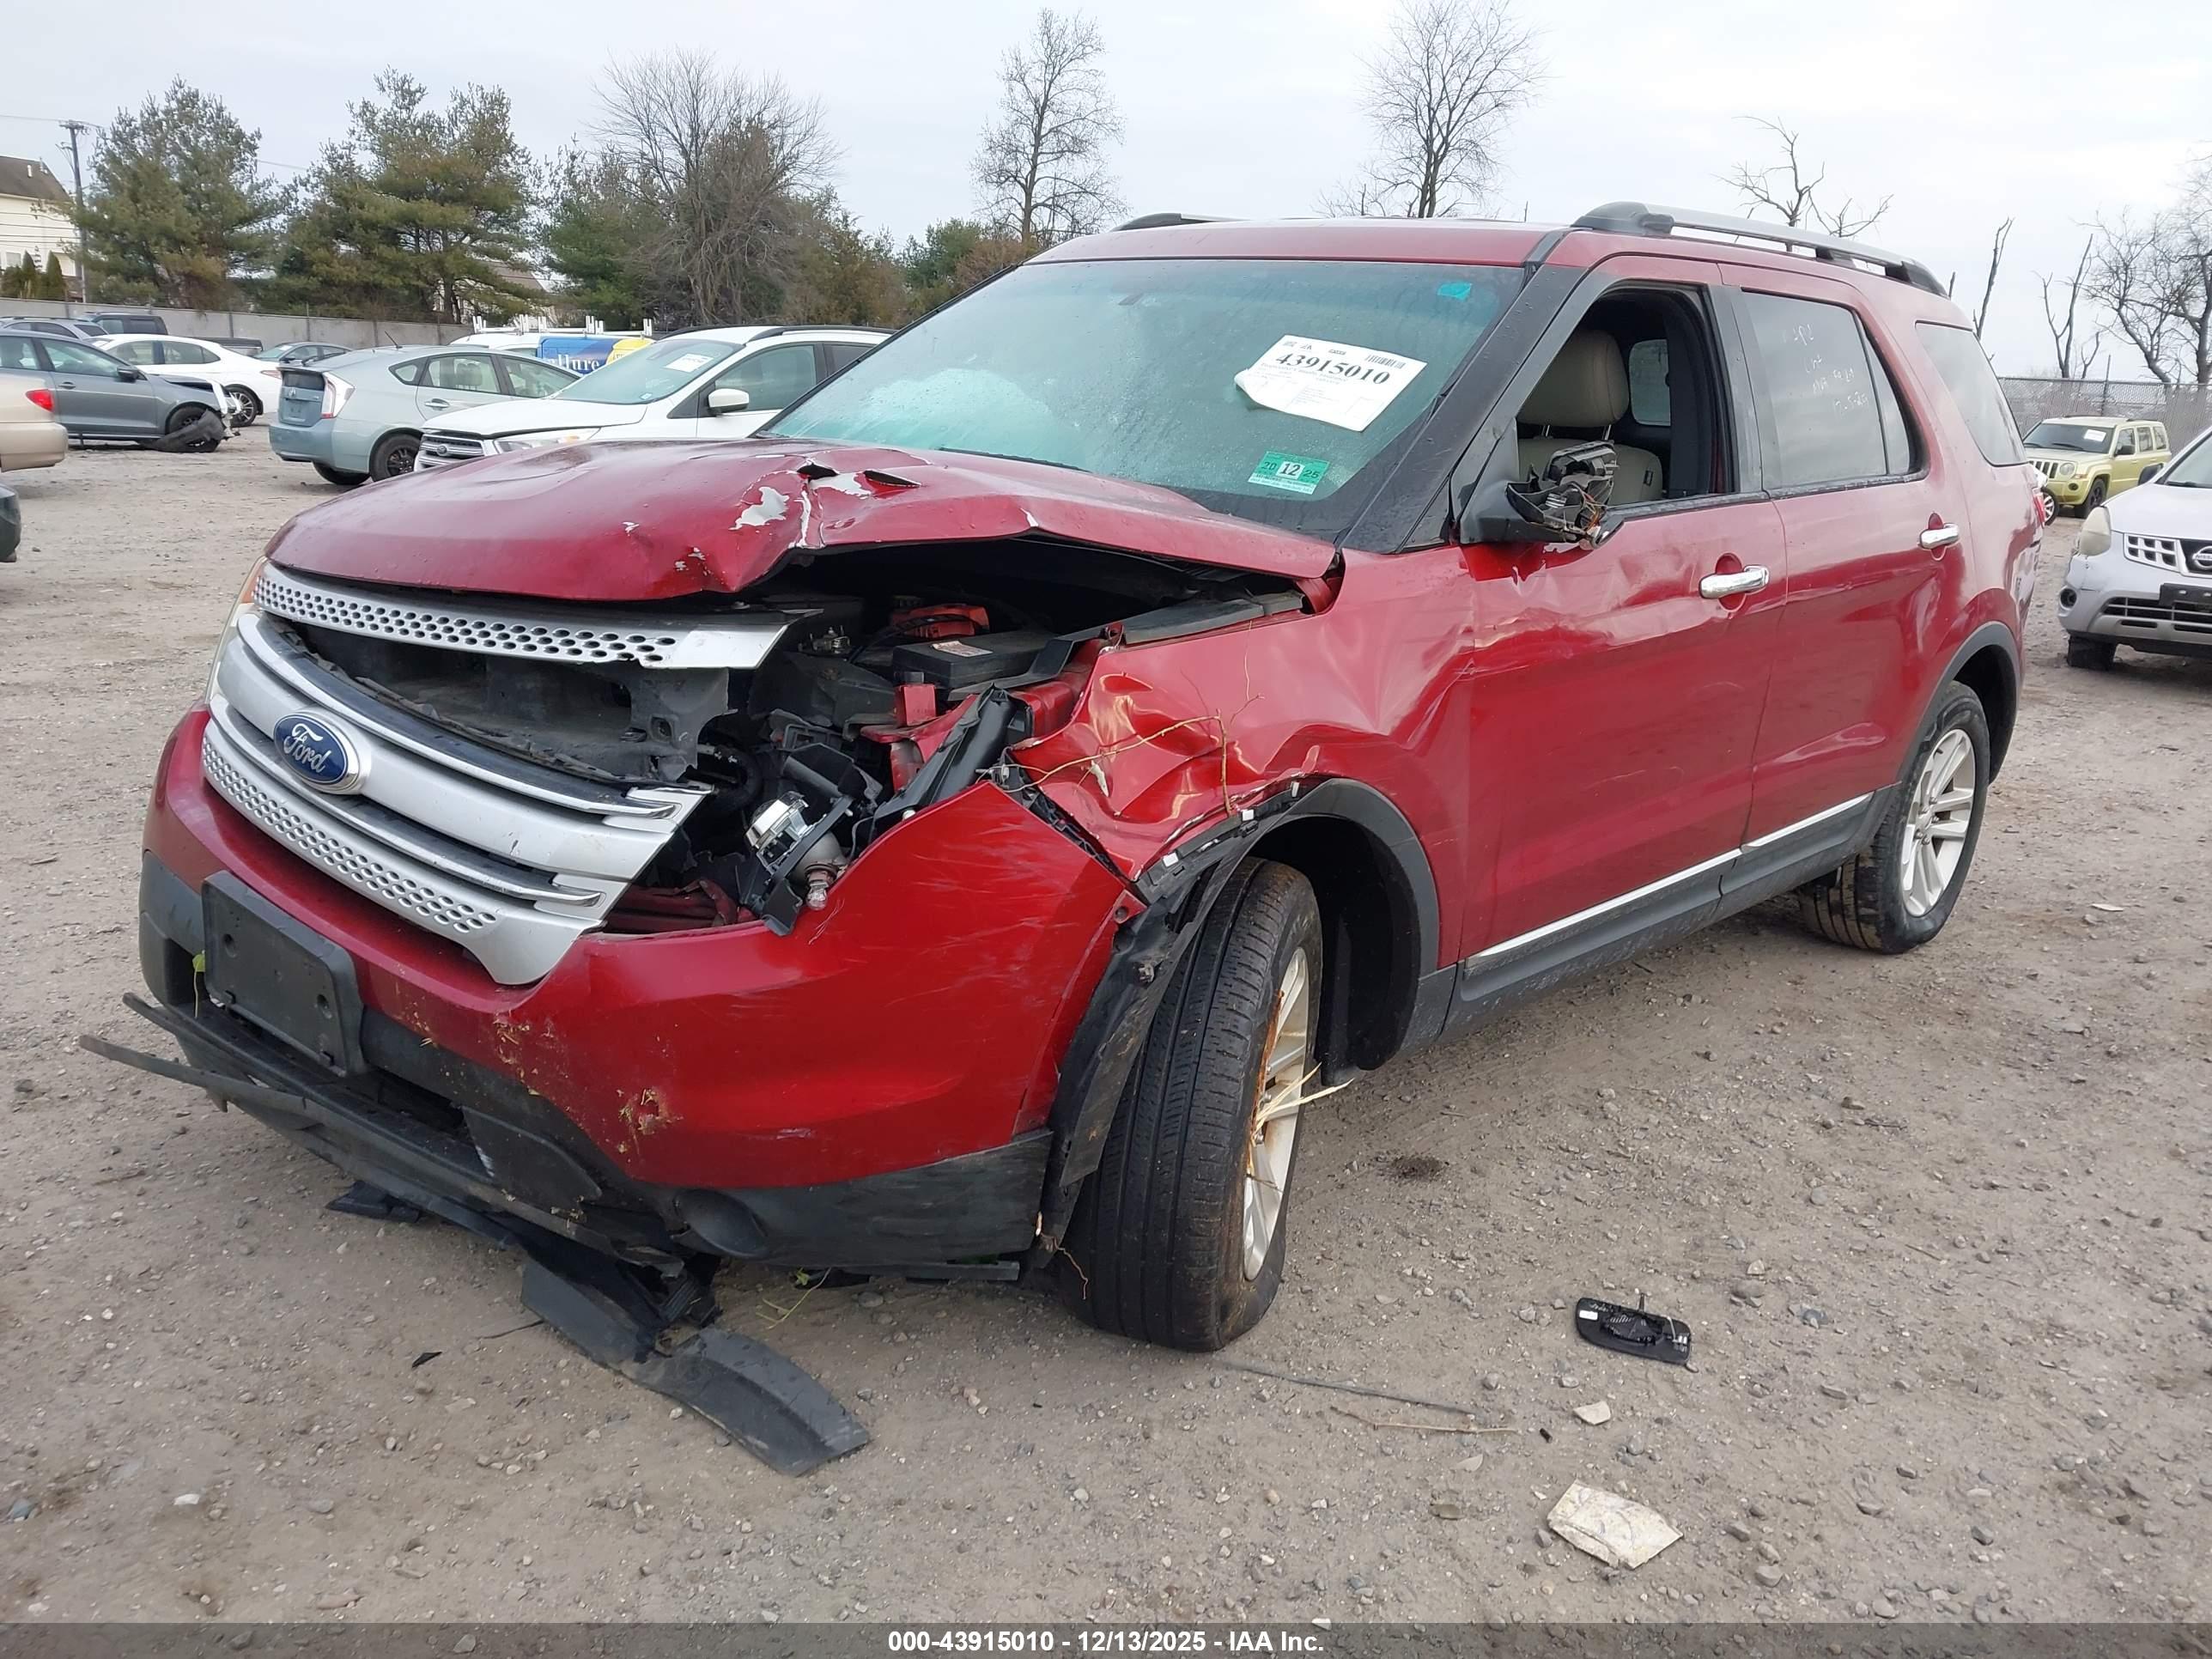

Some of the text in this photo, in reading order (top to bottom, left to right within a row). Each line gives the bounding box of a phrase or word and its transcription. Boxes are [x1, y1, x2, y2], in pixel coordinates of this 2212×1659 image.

[1276, 353, 1390, 385] 43915010
[1261, 461, 1320, 478] 20 12 25
[283, 723, 331, 773] Ford
